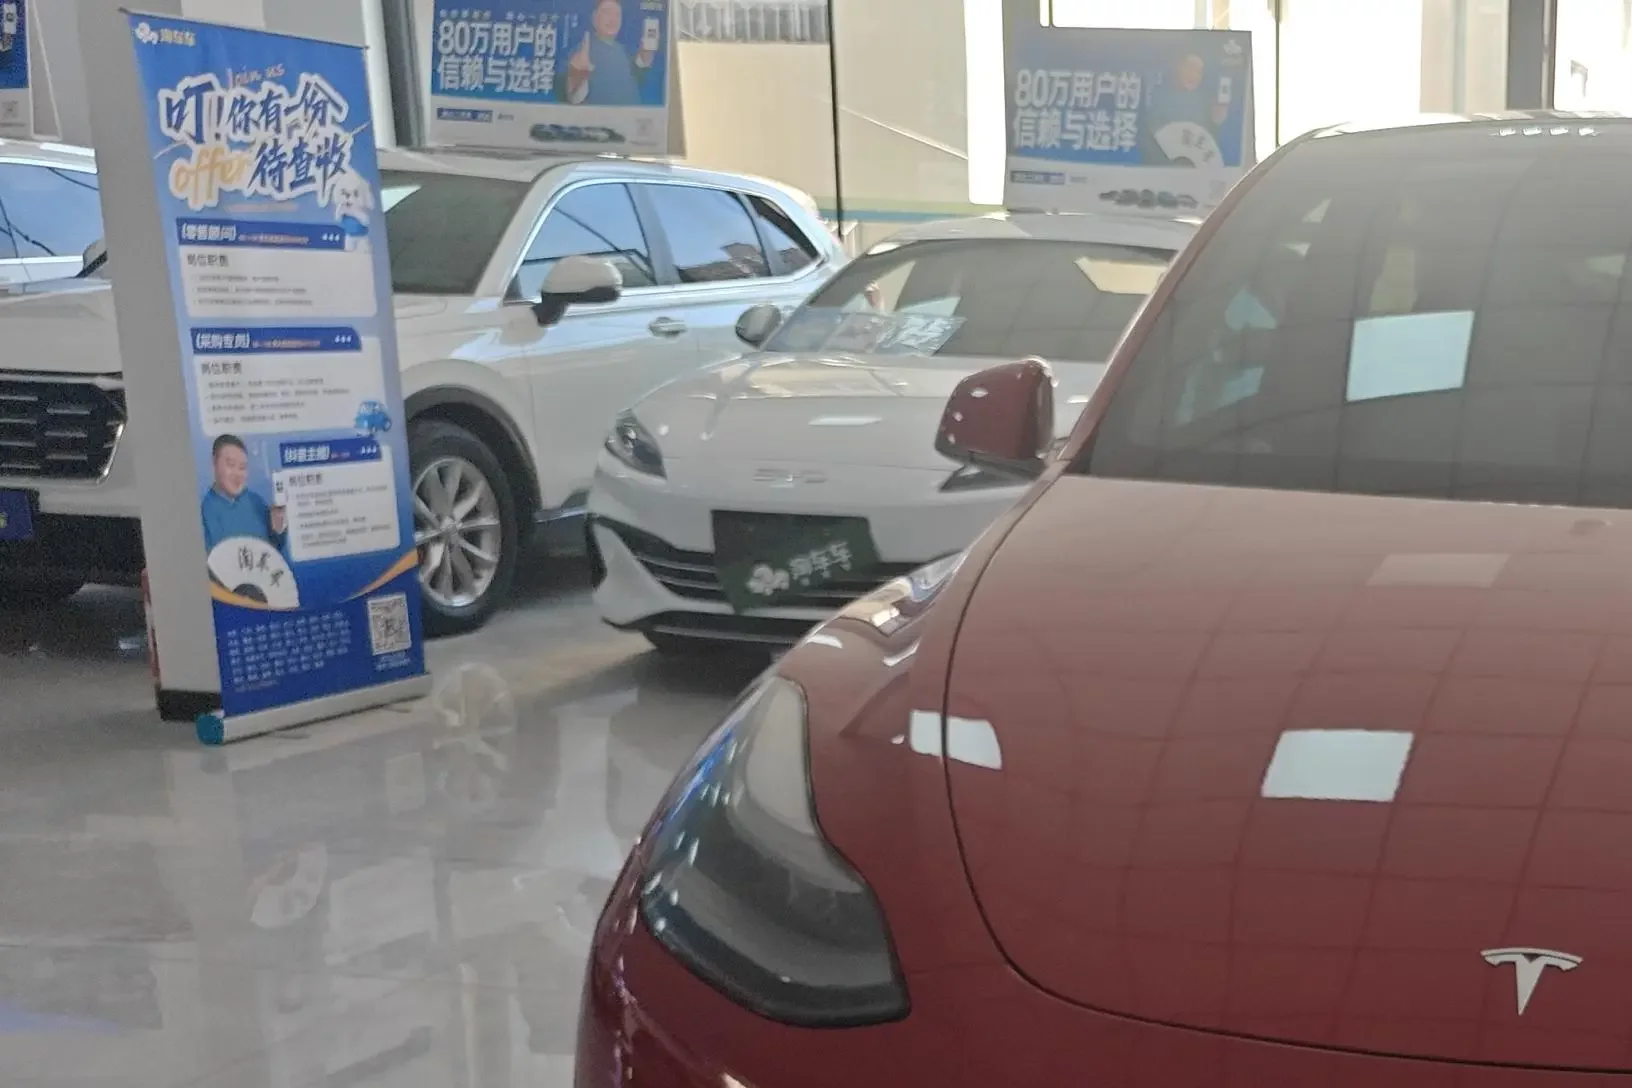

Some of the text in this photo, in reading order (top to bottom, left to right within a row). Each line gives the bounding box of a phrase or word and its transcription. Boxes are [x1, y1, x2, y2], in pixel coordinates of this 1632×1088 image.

[438, 20, 557, 57] 80万用户的
[437, 56, 556, 94] 信赖与选择
[1015, 69, 1142, 110] 80万用户的
[1013, 108, 1138, 152] 信赖与选择
